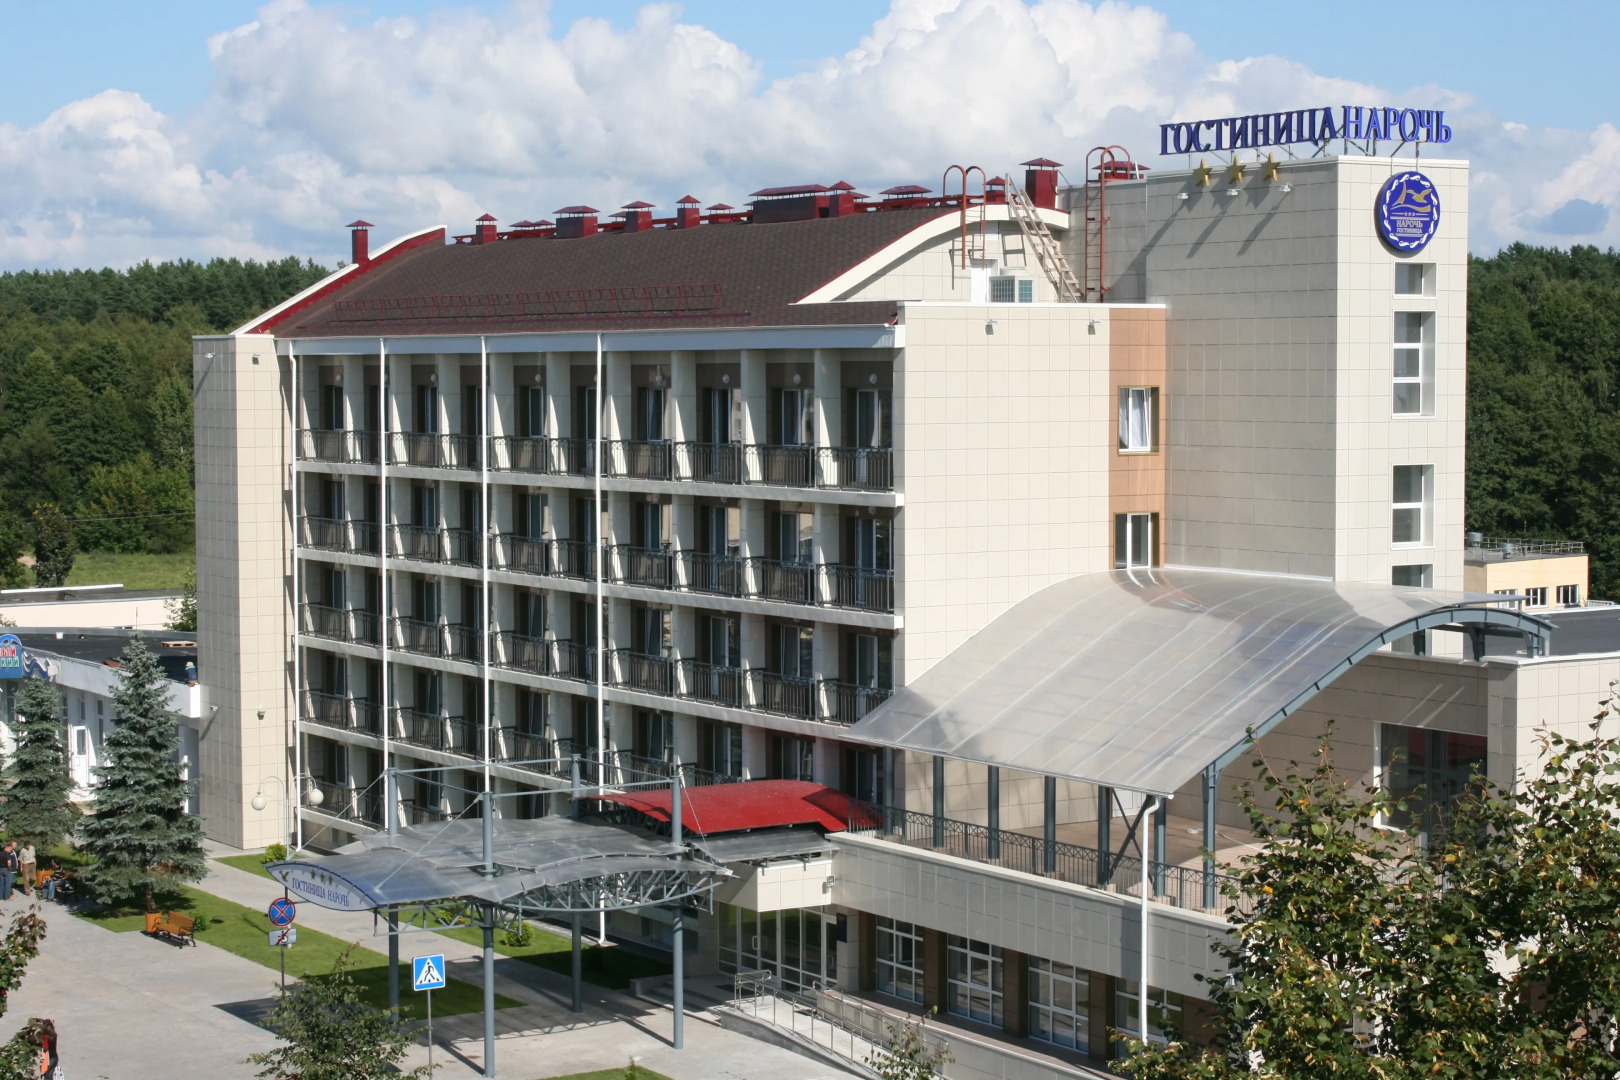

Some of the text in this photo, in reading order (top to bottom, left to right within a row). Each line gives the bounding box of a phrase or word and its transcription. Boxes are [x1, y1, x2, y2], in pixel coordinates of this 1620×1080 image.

[1160, 106, 1452, 155] ГОСТИНИЦА НАРОЧЬ
[1396, 220, 1423, 228] НАРОЧЬ
[0, 646, 16, 657] ЫЙ
[292, 877, 350, 907] ГОСТИНИЦА НАРОЧЬ
